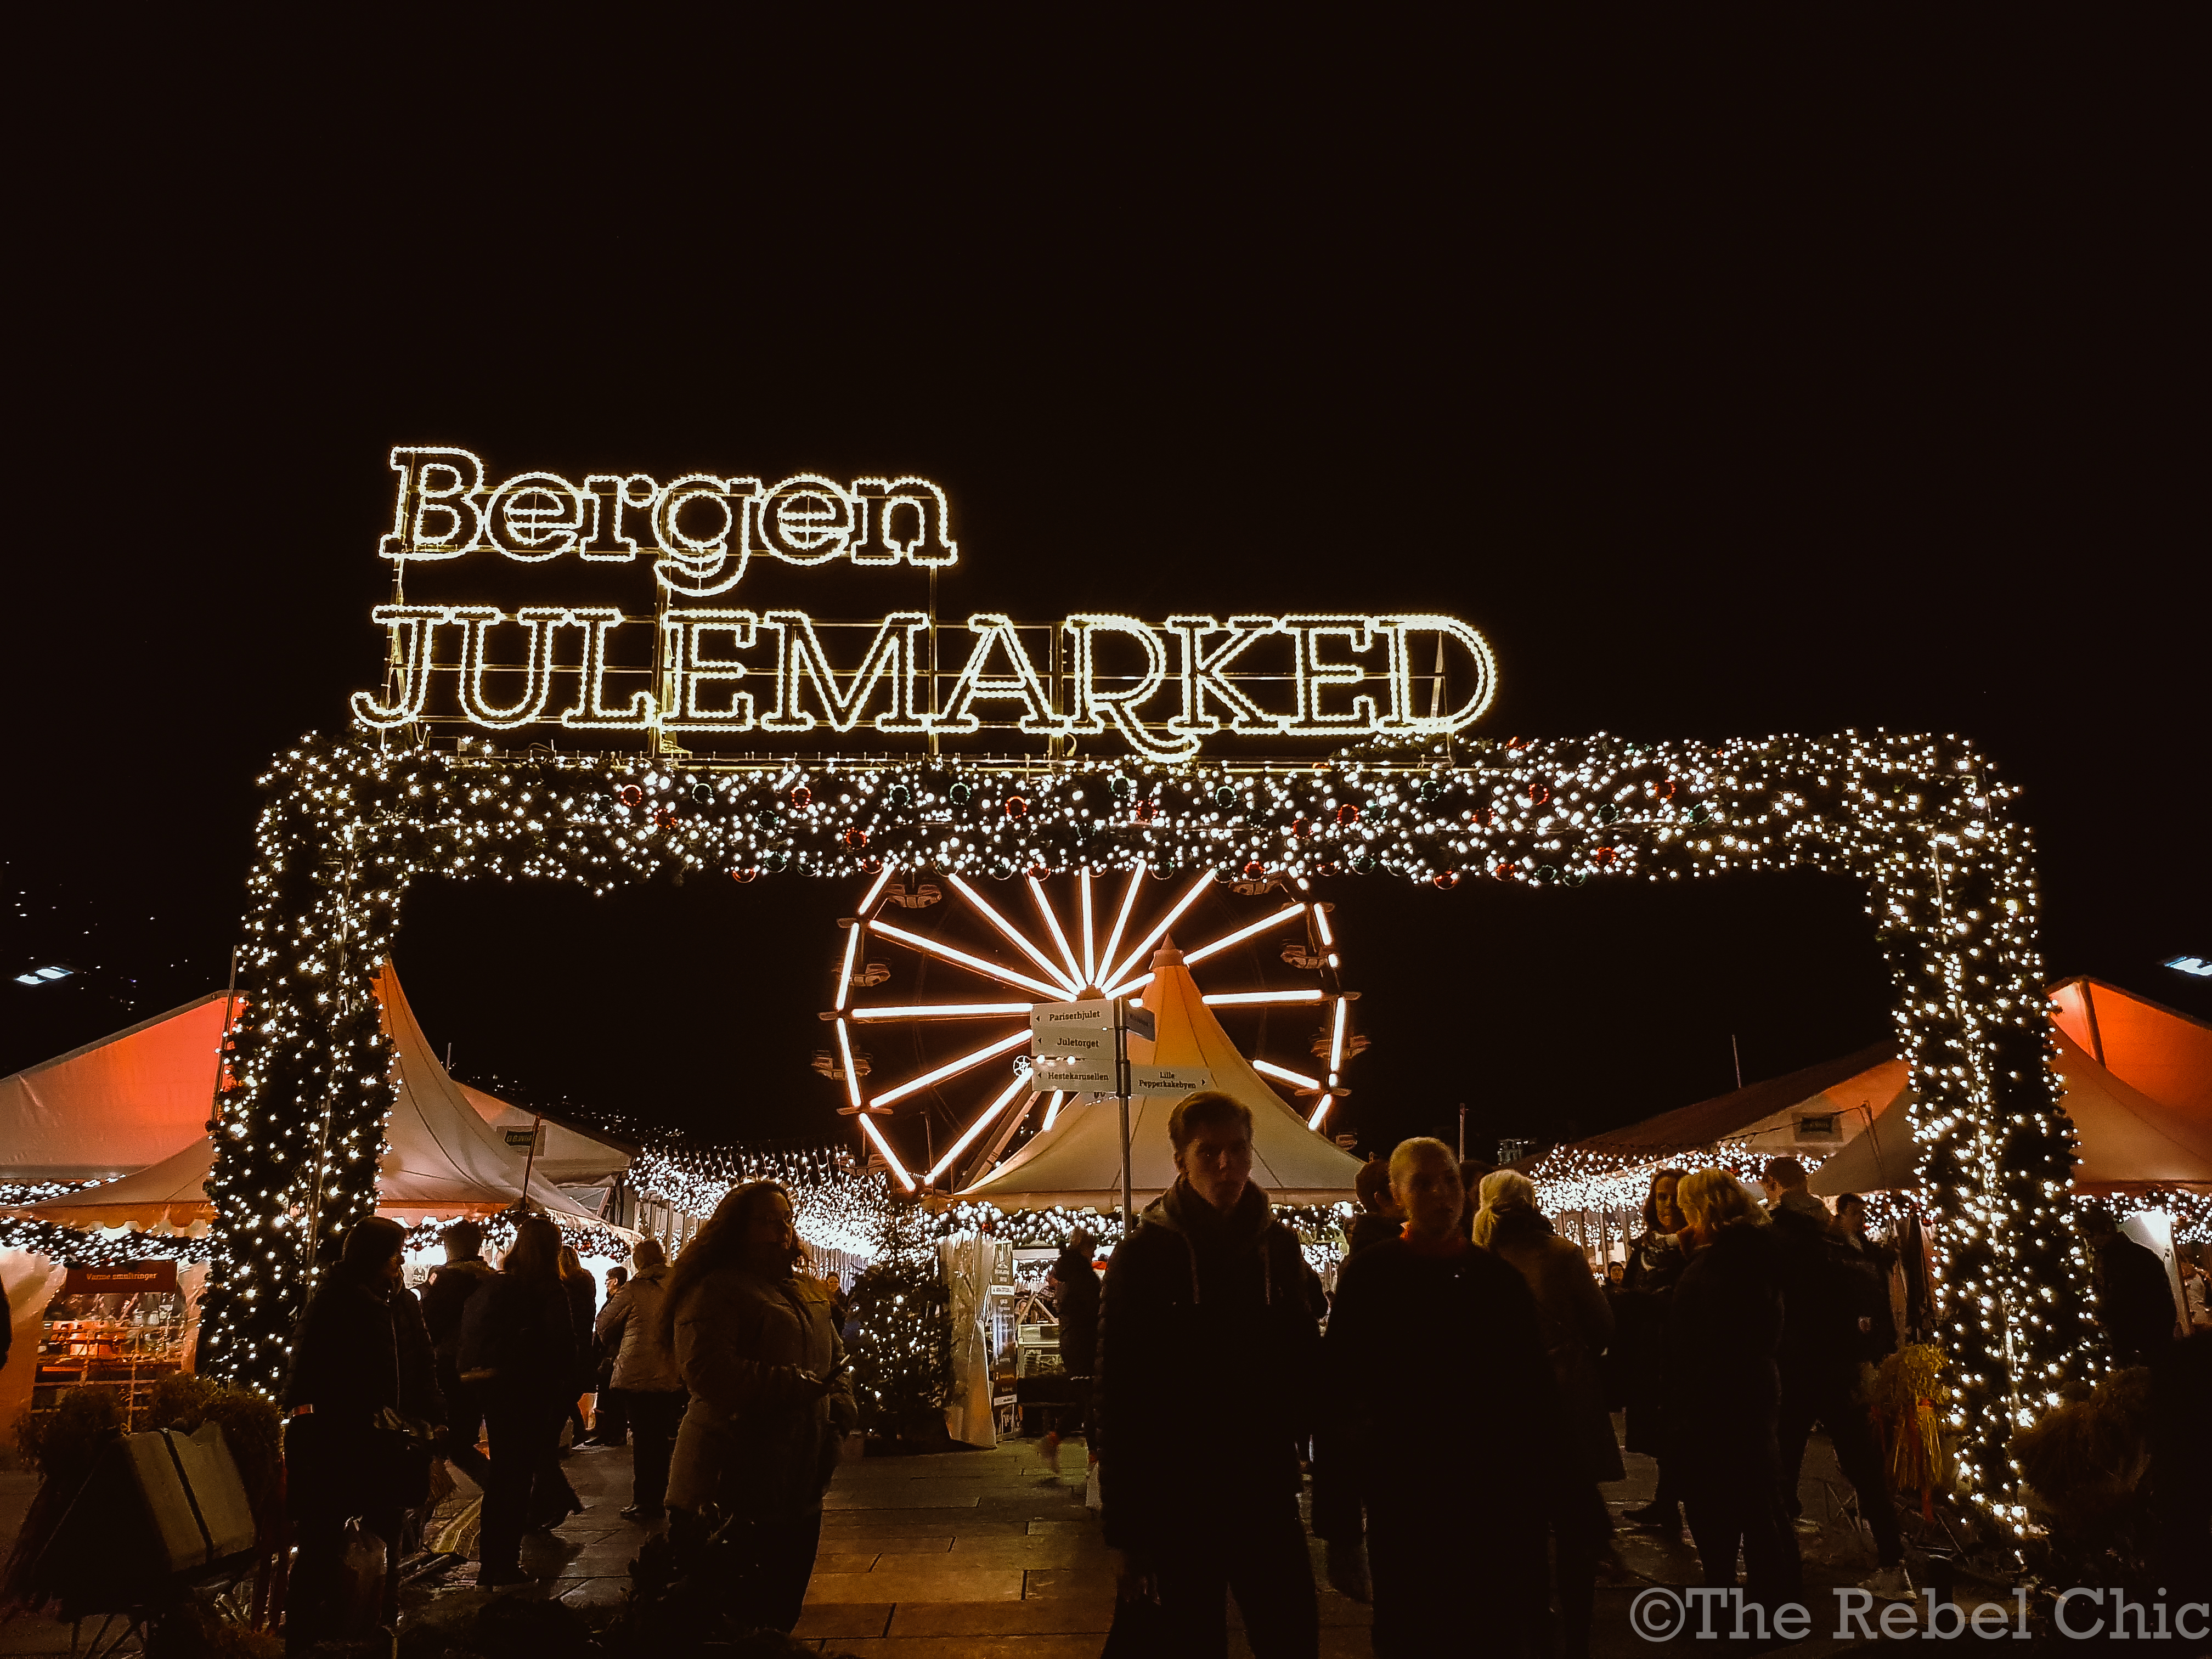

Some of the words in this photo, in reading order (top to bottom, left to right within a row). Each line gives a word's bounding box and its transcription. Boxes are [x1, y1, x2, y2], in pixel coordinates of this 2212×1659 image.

[379, 445, 959, 597] Bergen
[351, 605, 1497, 763] JULEMARKED
[1049, 1010, 1101, 1022] Pariserhjulet
[1057, 1037, 1100, 1049] Juletorget
[1048, 1071, 1109, 1081] Hestekarusellen
